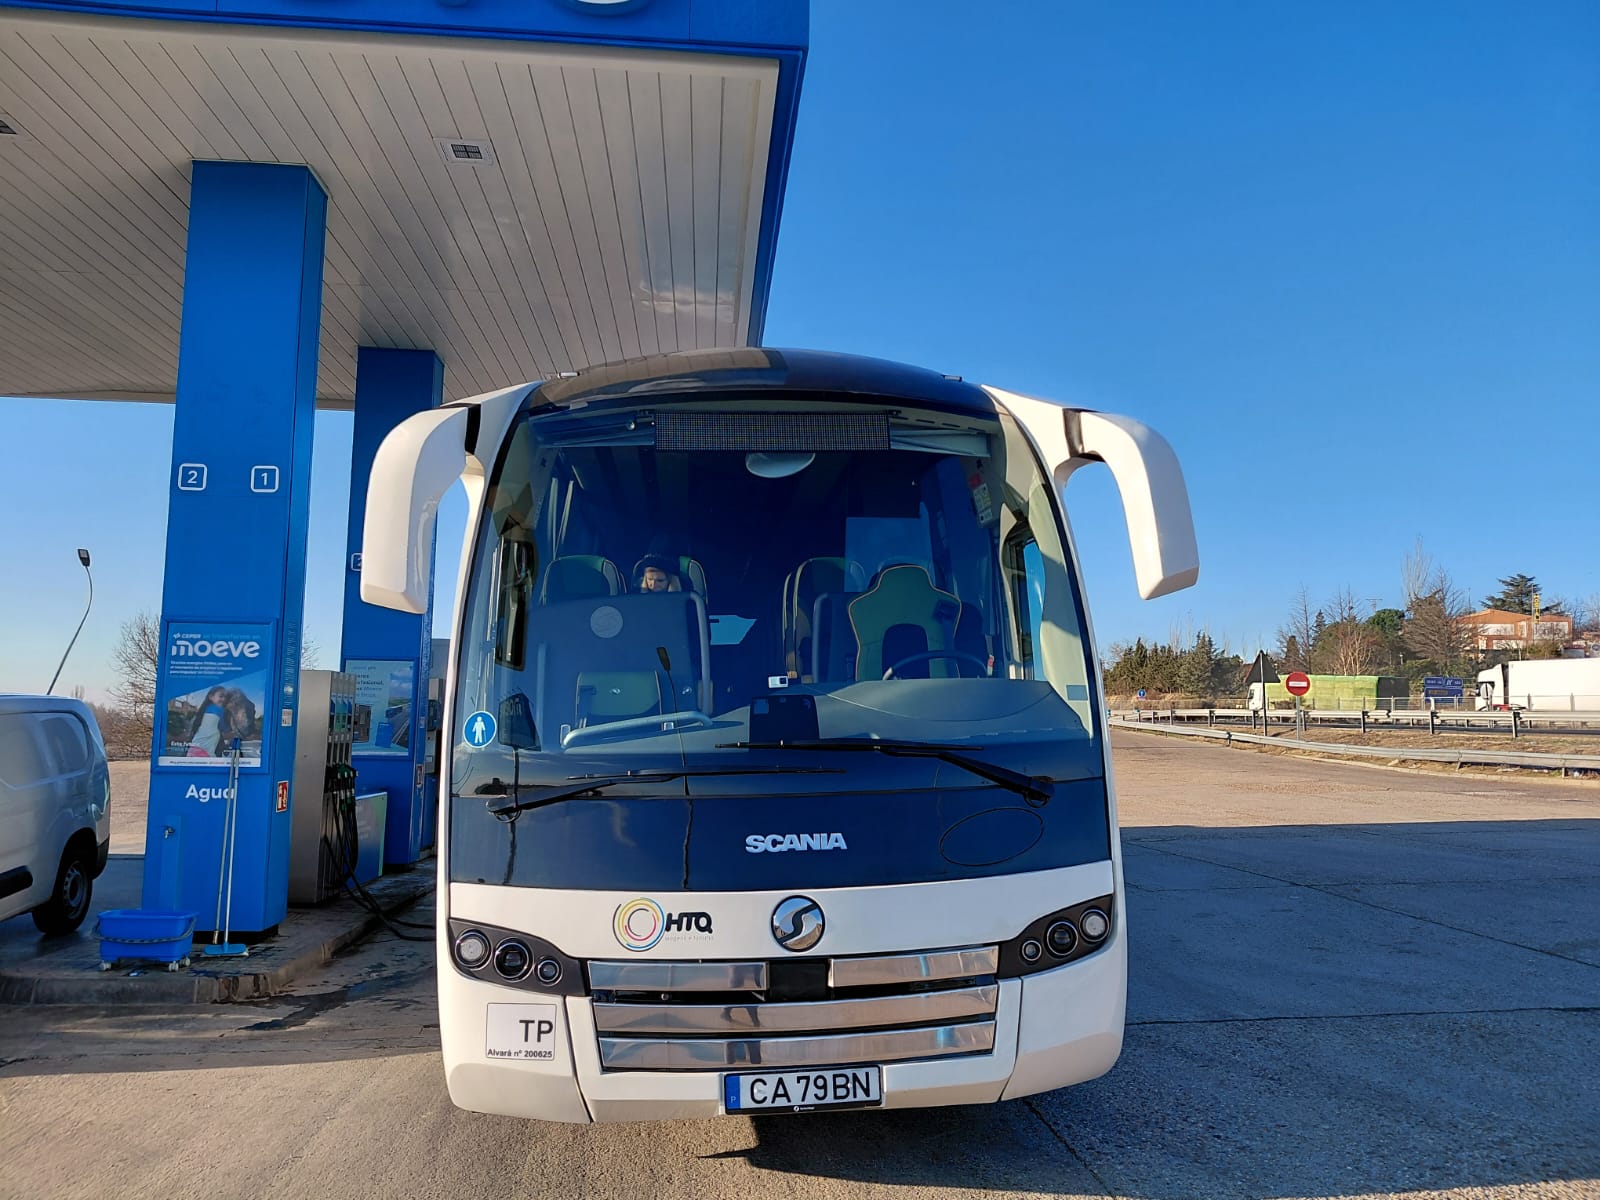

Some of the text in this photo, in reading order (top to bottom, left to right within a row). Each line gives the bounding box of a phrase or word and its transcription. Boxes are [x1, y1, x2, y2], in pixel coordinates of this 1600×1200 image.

[187, 470, 198, 484] 2
[261, 472, 268, 486] 1
[171, 640, 260, 658] moeve
[185, 784, 235, 802] Agua
[745, 832, 848, 853] SCANIA
[665, 911, 713, 934] HTQ
[519, 1019, 554, 1043] TP
[487, 1048, 552, 1058] Alvará nº 200625
